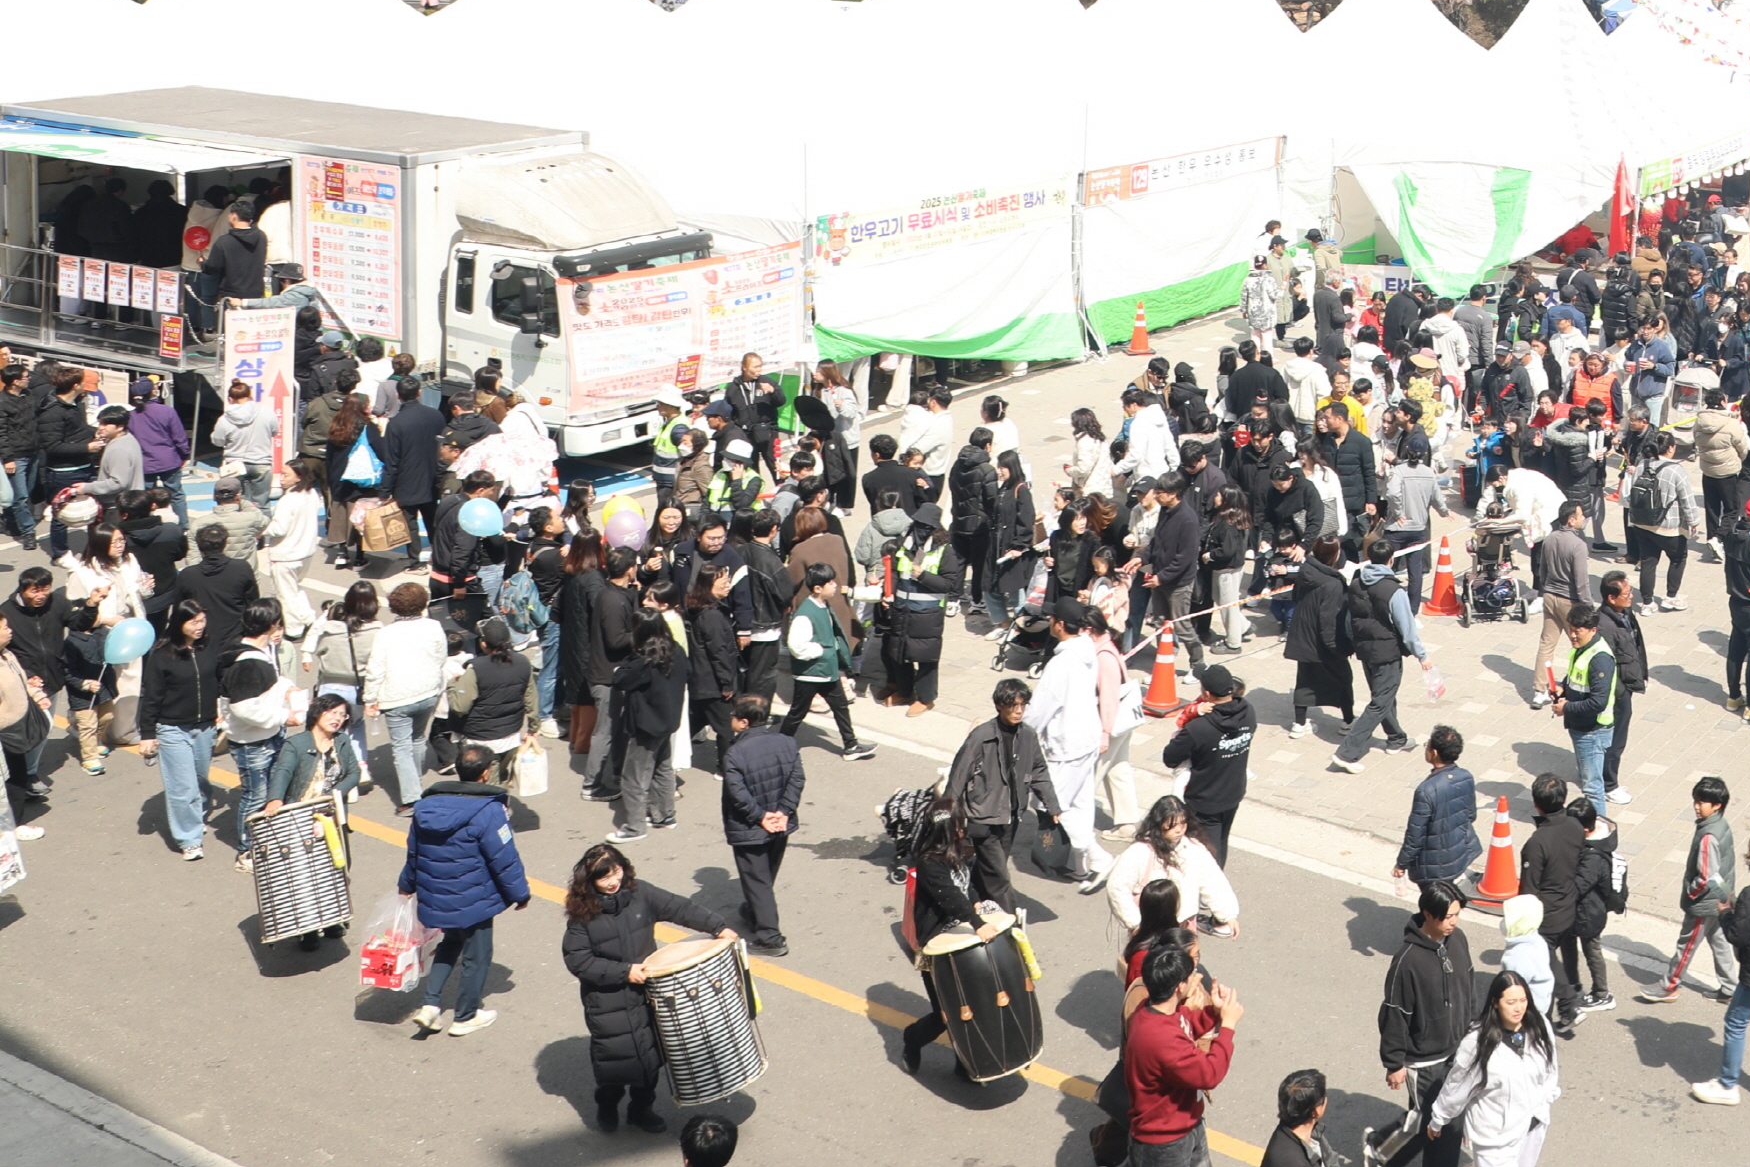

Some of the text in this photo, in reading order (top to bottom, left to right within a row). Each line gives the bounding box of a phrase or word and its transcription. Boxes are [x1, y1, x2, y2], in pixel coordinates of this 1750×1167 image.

[1151, 164, 1171, 180] 논산
[1178, 158, 1197, 174] 한우
[1204, 151, 1232, 167] 우수성
[1239, 148, 1256, 163] 홍보
[920, 187, 986, 210] 2025 논산딸기축제
[850, 216, 903, 243] 한우고기
[907, 206, 958, 232] 무료시식
[961, 206, 971, 221] 및
[973, 193, 1020, 219] 소비촉진
[1022, 189, 1045, 209] 행사
[746, 252, 790, 271] 논산딸기축제
[606, 275, 679, 293] 논산딸기축제
[611, 296, 644, 306] 2025
[572, 322, 593, 332] 맛도
[595, 319, 621, 329] 가격도
[1219, 733, 1251, 750] Sports
